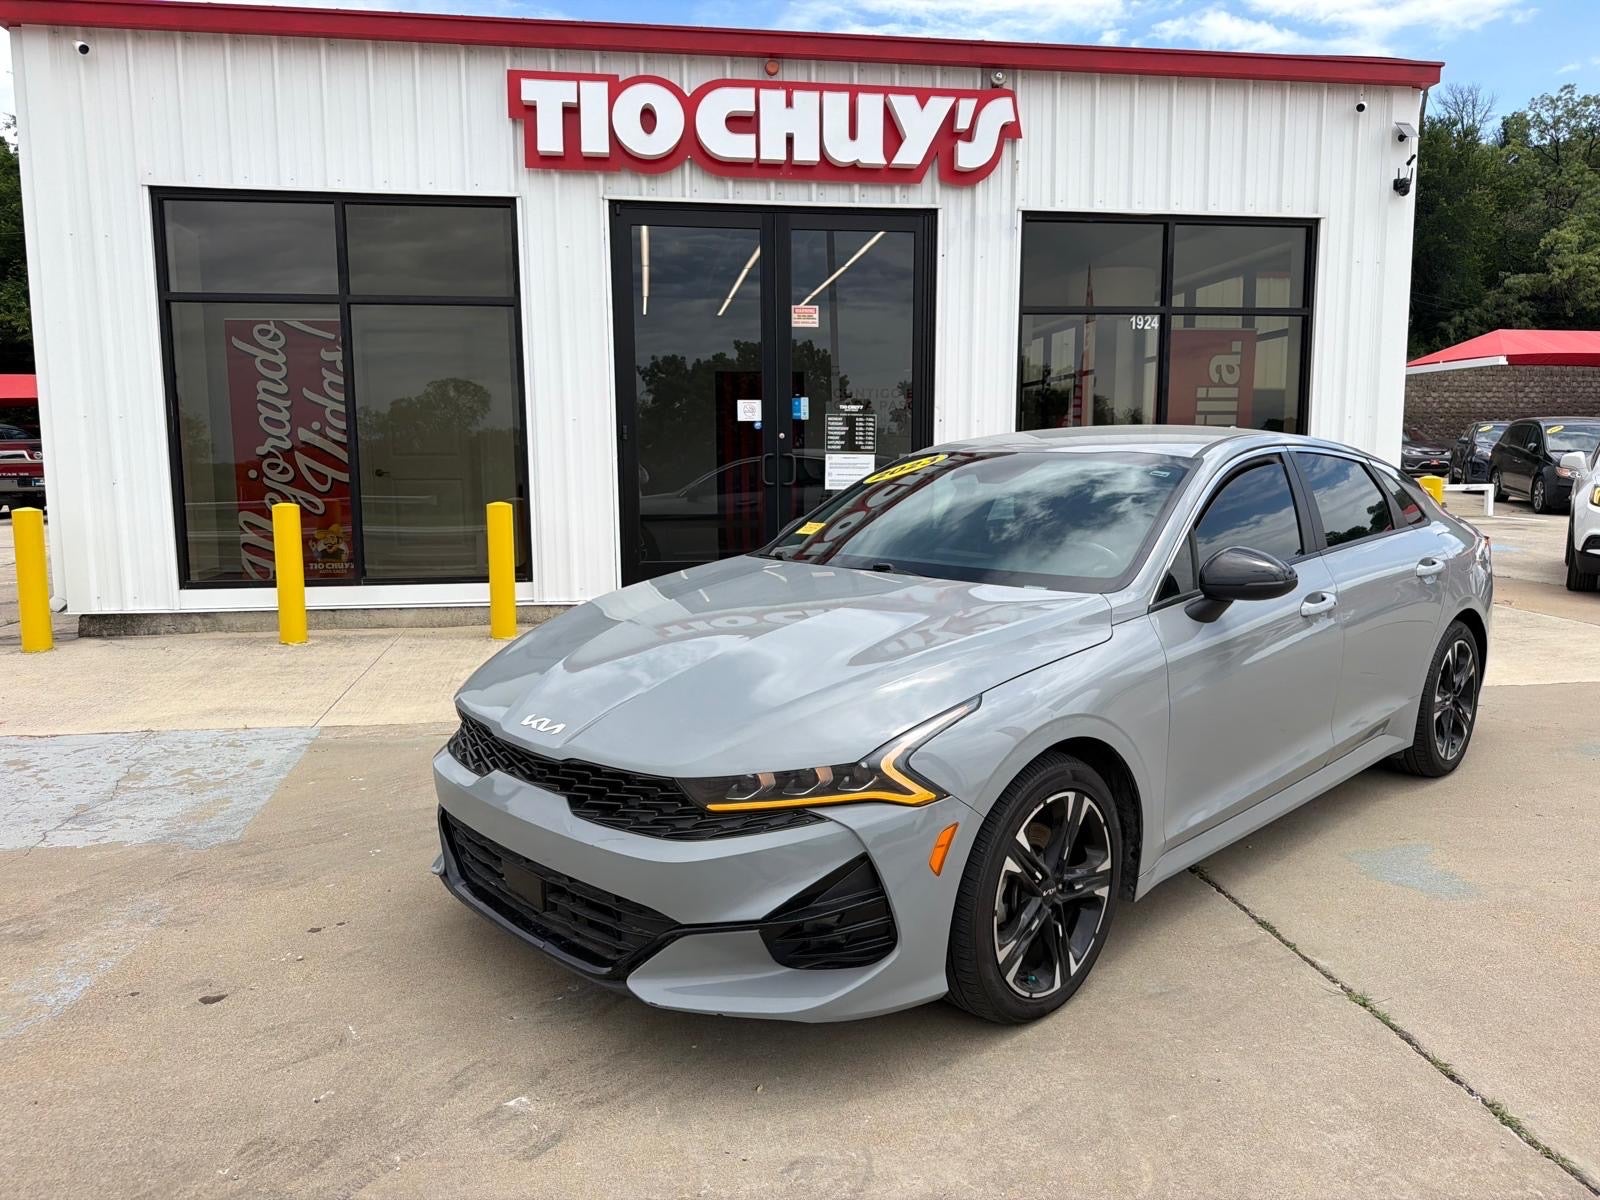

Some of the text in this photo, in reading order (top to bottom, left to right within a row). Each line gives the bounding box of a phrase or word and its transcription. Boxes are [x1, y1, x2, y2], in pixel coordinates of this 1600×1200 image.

[520, 78, 1016, 172] TIO CHUY'S
[1130, 315, 1159, 330] 1924
[520, 713, 566, 735] KIA
